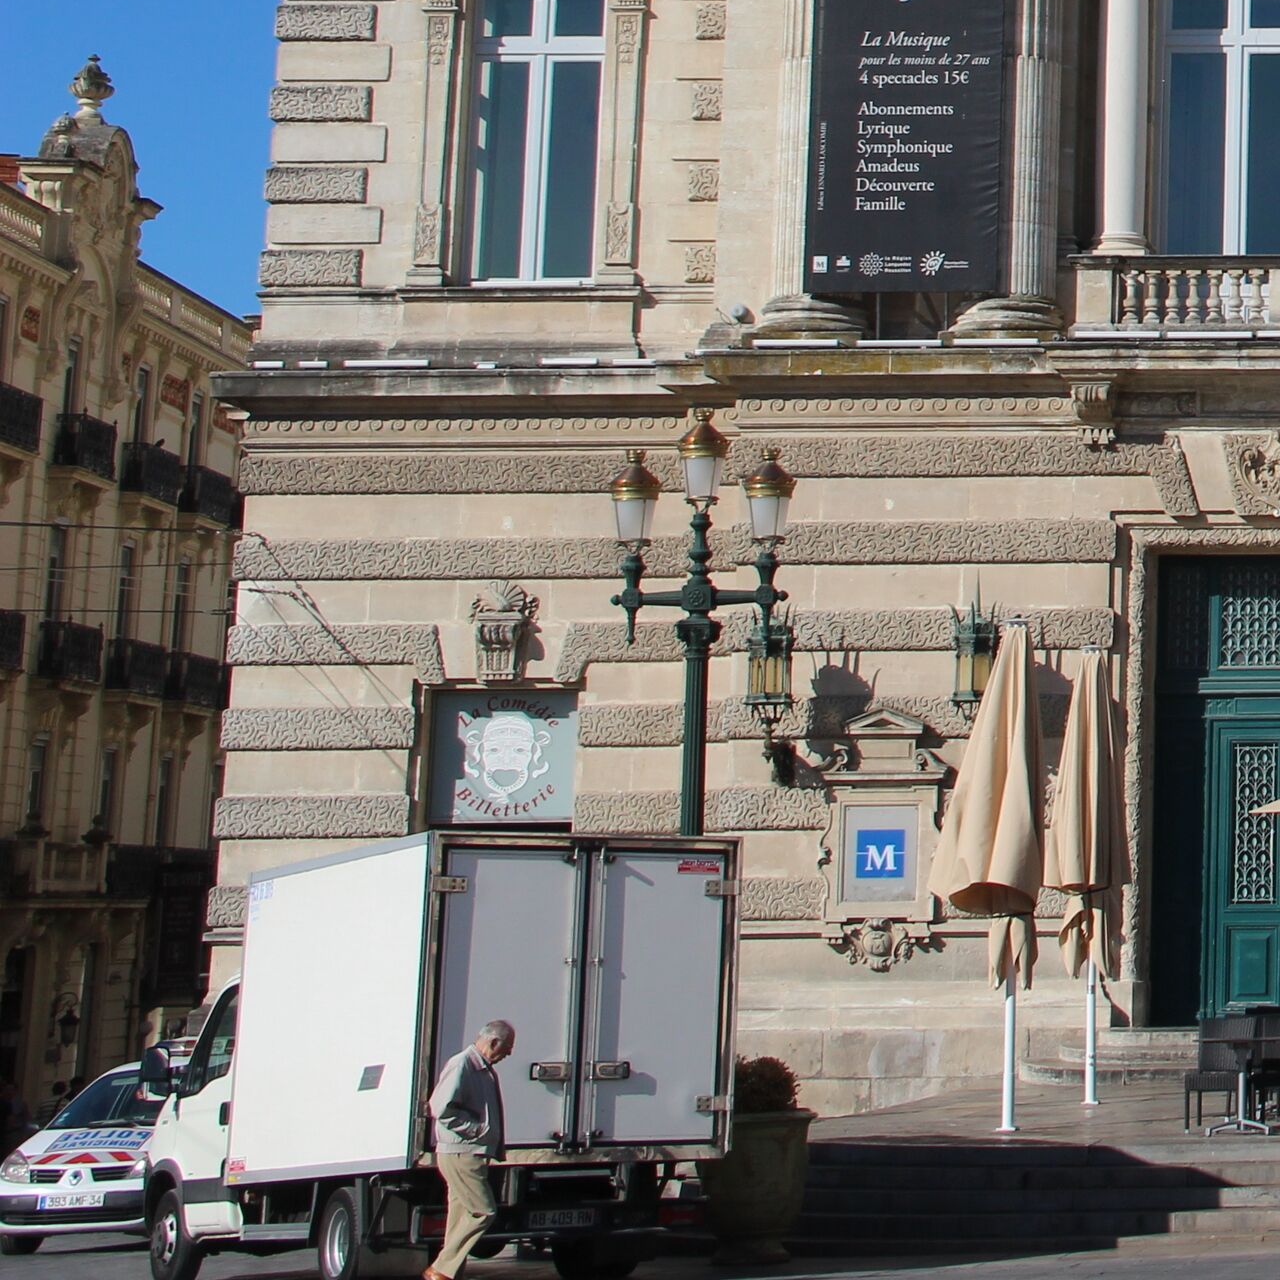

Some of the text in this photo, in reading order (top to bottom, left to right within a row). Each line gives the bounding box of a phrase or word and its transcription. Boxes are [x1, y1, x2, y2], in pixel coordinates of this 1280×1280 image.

[861, 31, 951, 51] La Musique
[858, 53, 990, 69] pour les moins de 27 ans
[858, 70, 970, 88] 4 spectacles 15€
[858, 101, 954, 115] Abonnements
[857, 120, 910, 136] Lyrique
[856, 140, 953, 157] Symphonique
[856, 158, 920, 172] Amadeus
[855, 177, 935, 191] Découverte
[854, 196, 906, 211] Famille
[458, 696, 559, 728] La Comédie
[456, 783, 555, 817] Billetterie
[864, 844, 897, 871] M
[48, 1194, 102, 1207] 393 AMF 34
